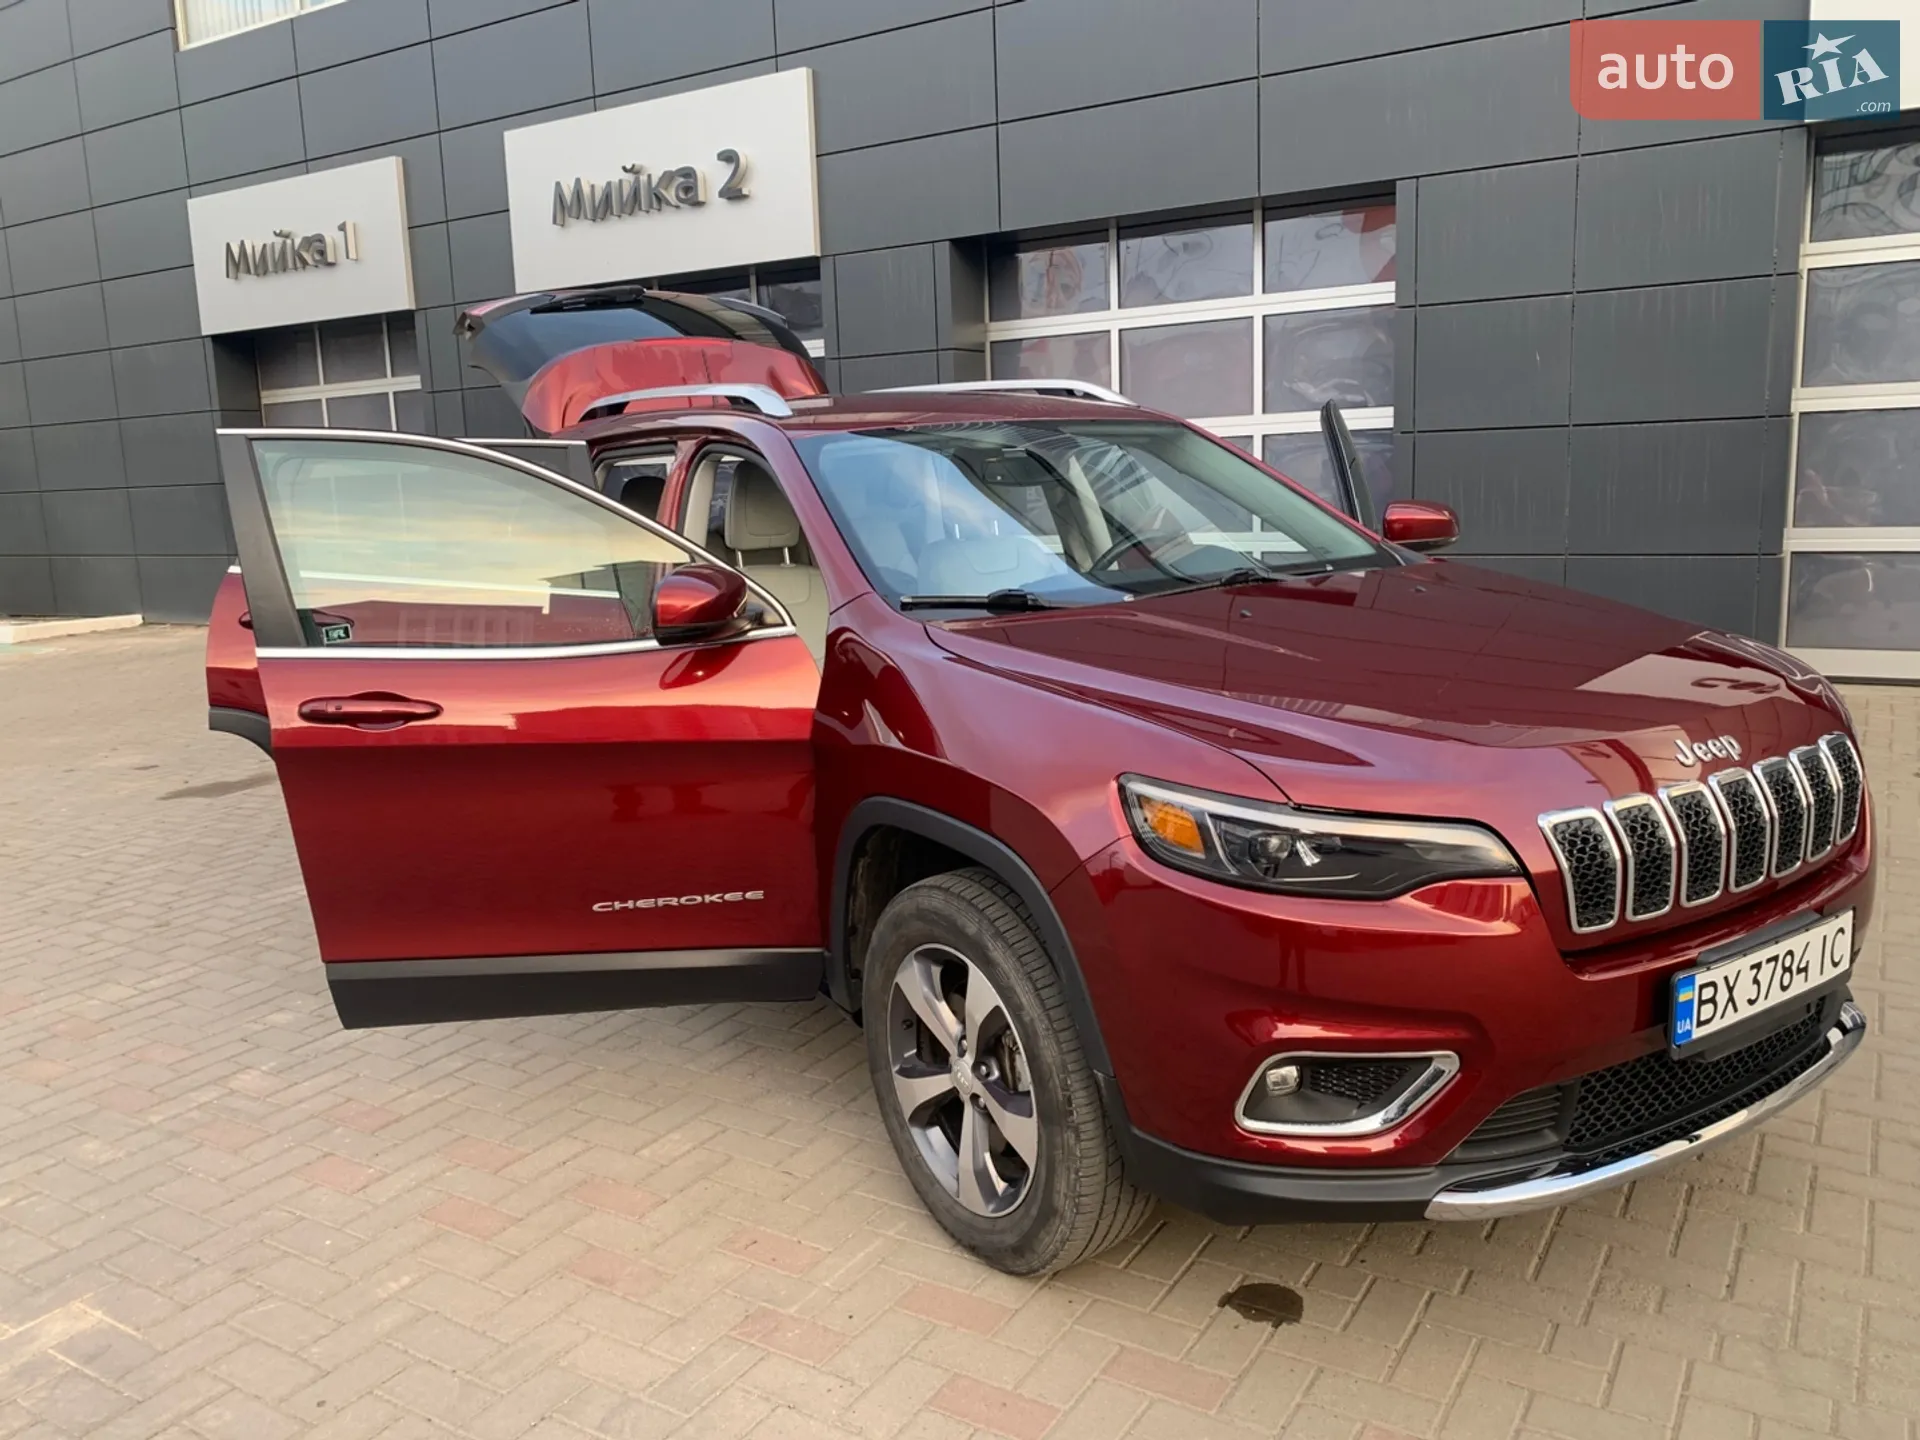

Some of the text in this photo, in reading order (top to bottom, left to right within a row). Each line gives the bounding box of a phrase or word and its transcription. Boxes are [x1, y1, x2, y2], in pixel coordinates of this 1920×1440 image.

[552, 148, 751, 228] Мийка 2
[225, 220, 358, 280] Мийка 1
[1674, 734, 1742, 767] Jeep
[592, 890, 764, 912] CHEROKEE
[1696, 926, 1846, 1029] BX 3784 IC
[1677, 1018, 1692, 1034] UA
